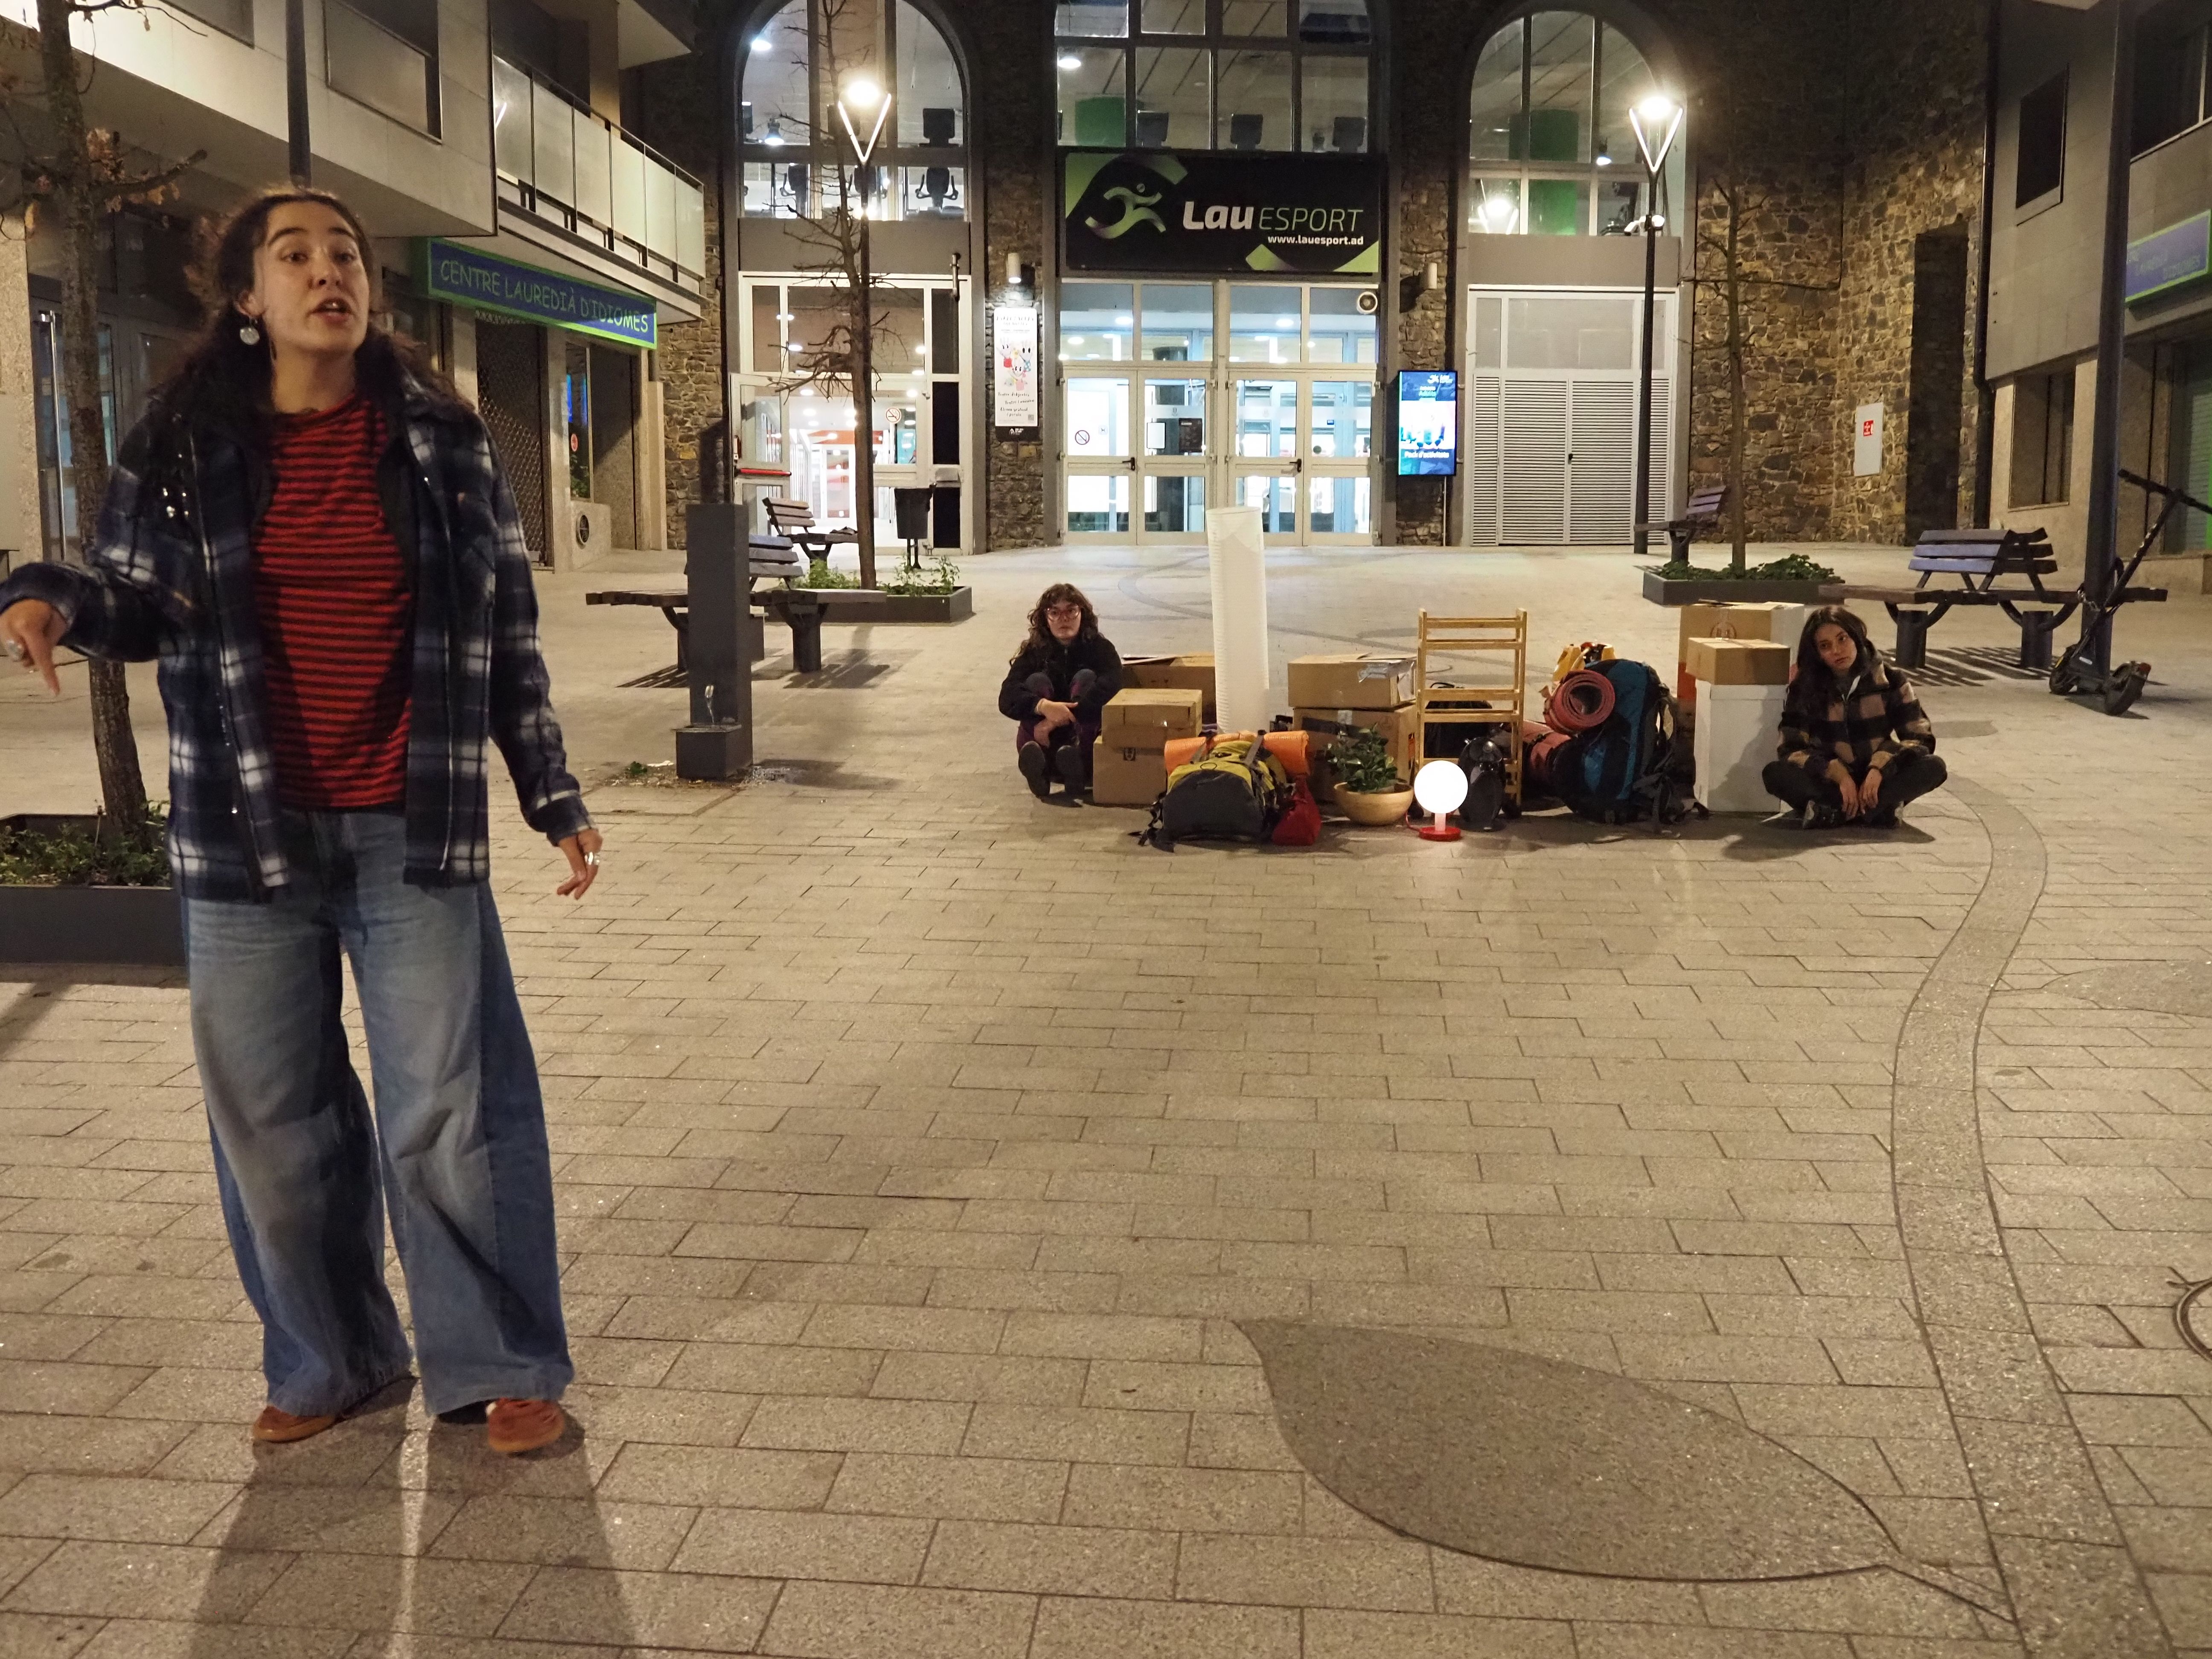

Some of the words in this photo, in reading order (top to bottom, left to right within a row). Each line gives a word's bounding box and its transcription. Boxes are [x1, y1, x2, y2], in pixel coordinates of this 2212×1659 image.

[1183, 201, 1254, 230] Lau
[1259, 207, 1364, 232] ESPORT
[1267, 235, 1364, 247] www.lauesport.ad
[440, 259, 501, 297] CENTRE
[505, 276, 576, 314] LAUREDIÀ
[580, 296, 649, 333] D'IDIOMES
